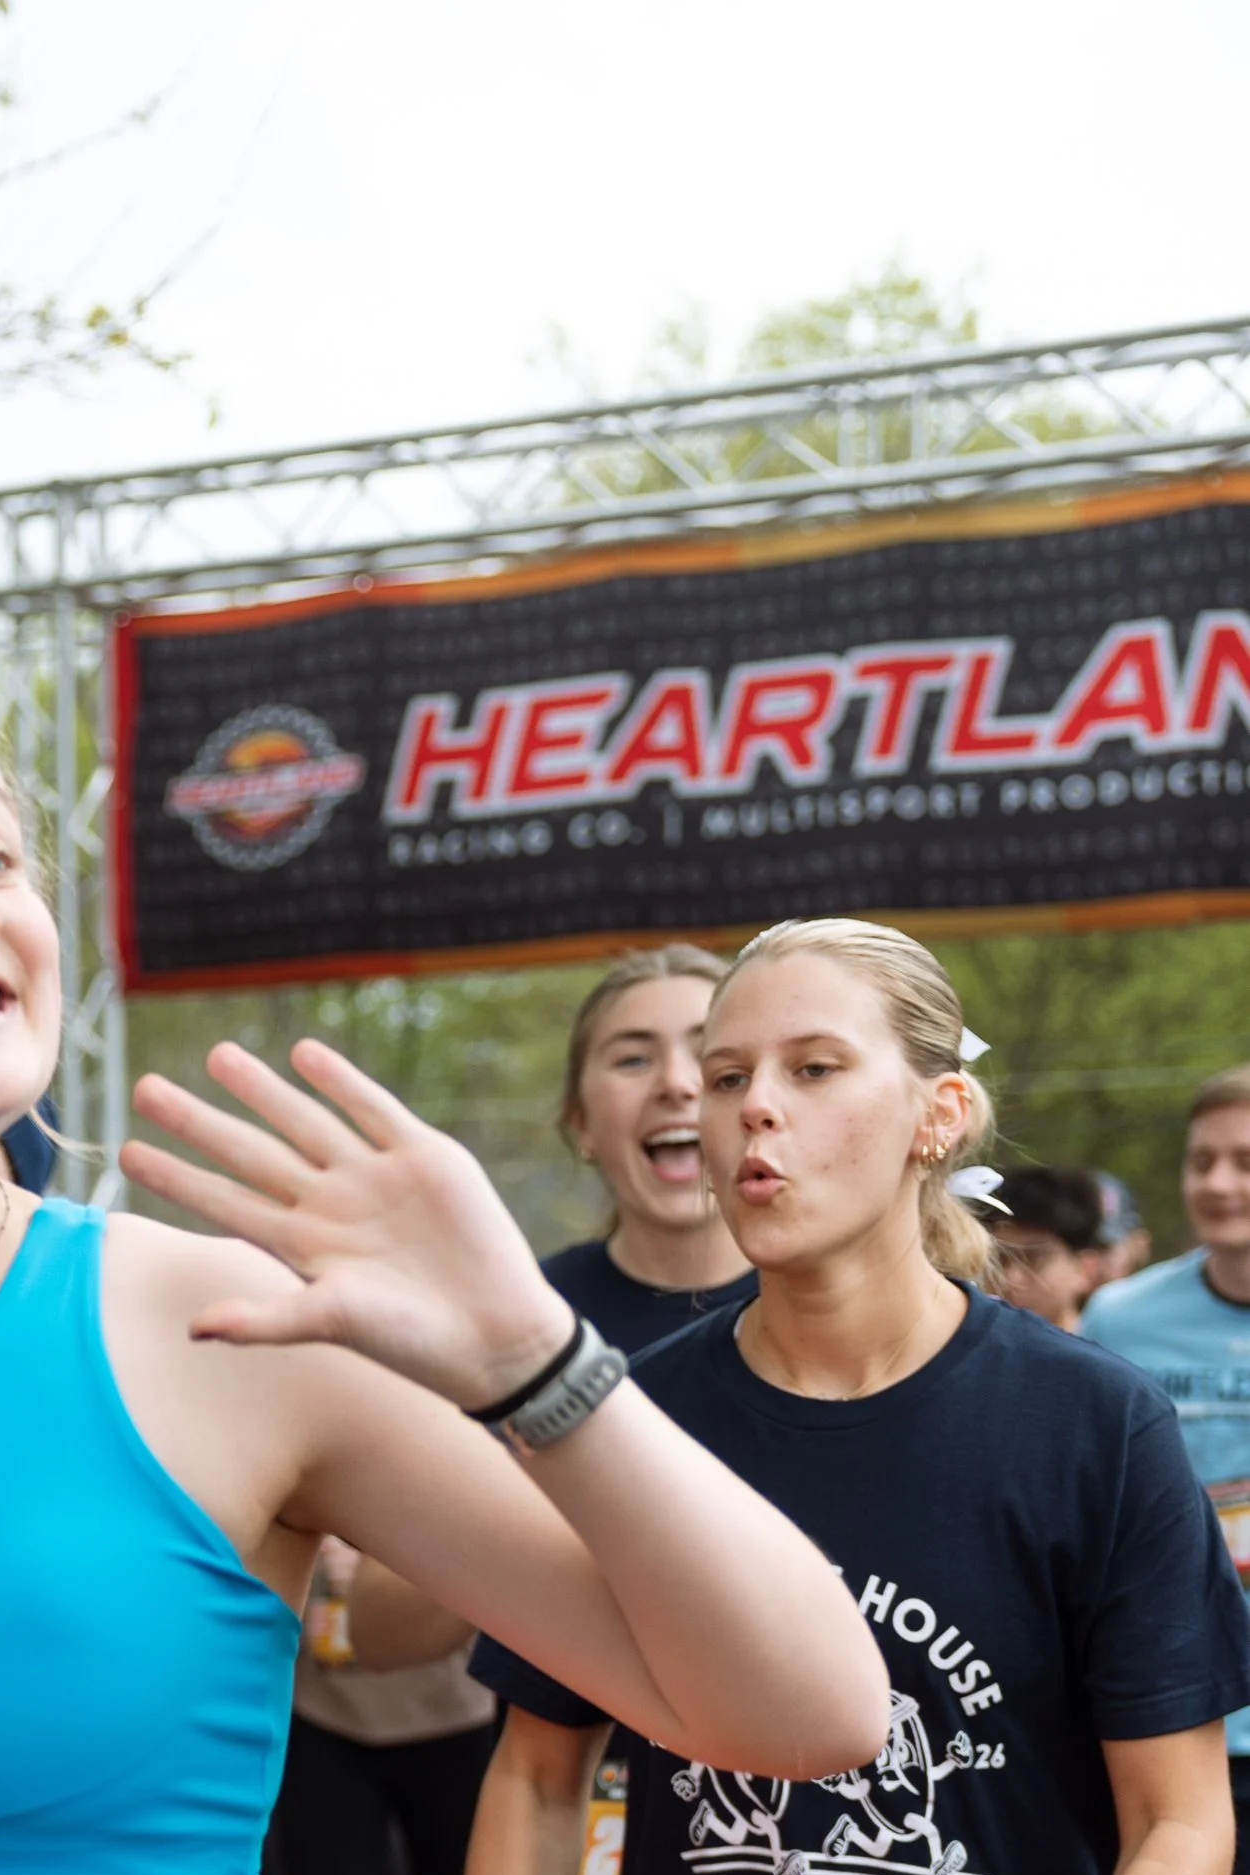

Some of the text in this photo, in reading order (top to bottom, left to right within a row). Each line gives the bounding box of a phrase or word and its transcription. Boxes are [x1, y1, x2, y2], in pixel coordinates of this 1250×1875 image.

[388, 818, 552, 868] RACING
[567, 809, 647, 850] CO.
[701, 781, 983, 842] MULTISPORT
[999, 757, 1250, 815] PRODUCTI
[858, 1574, 1003, 1716] HOUSE
